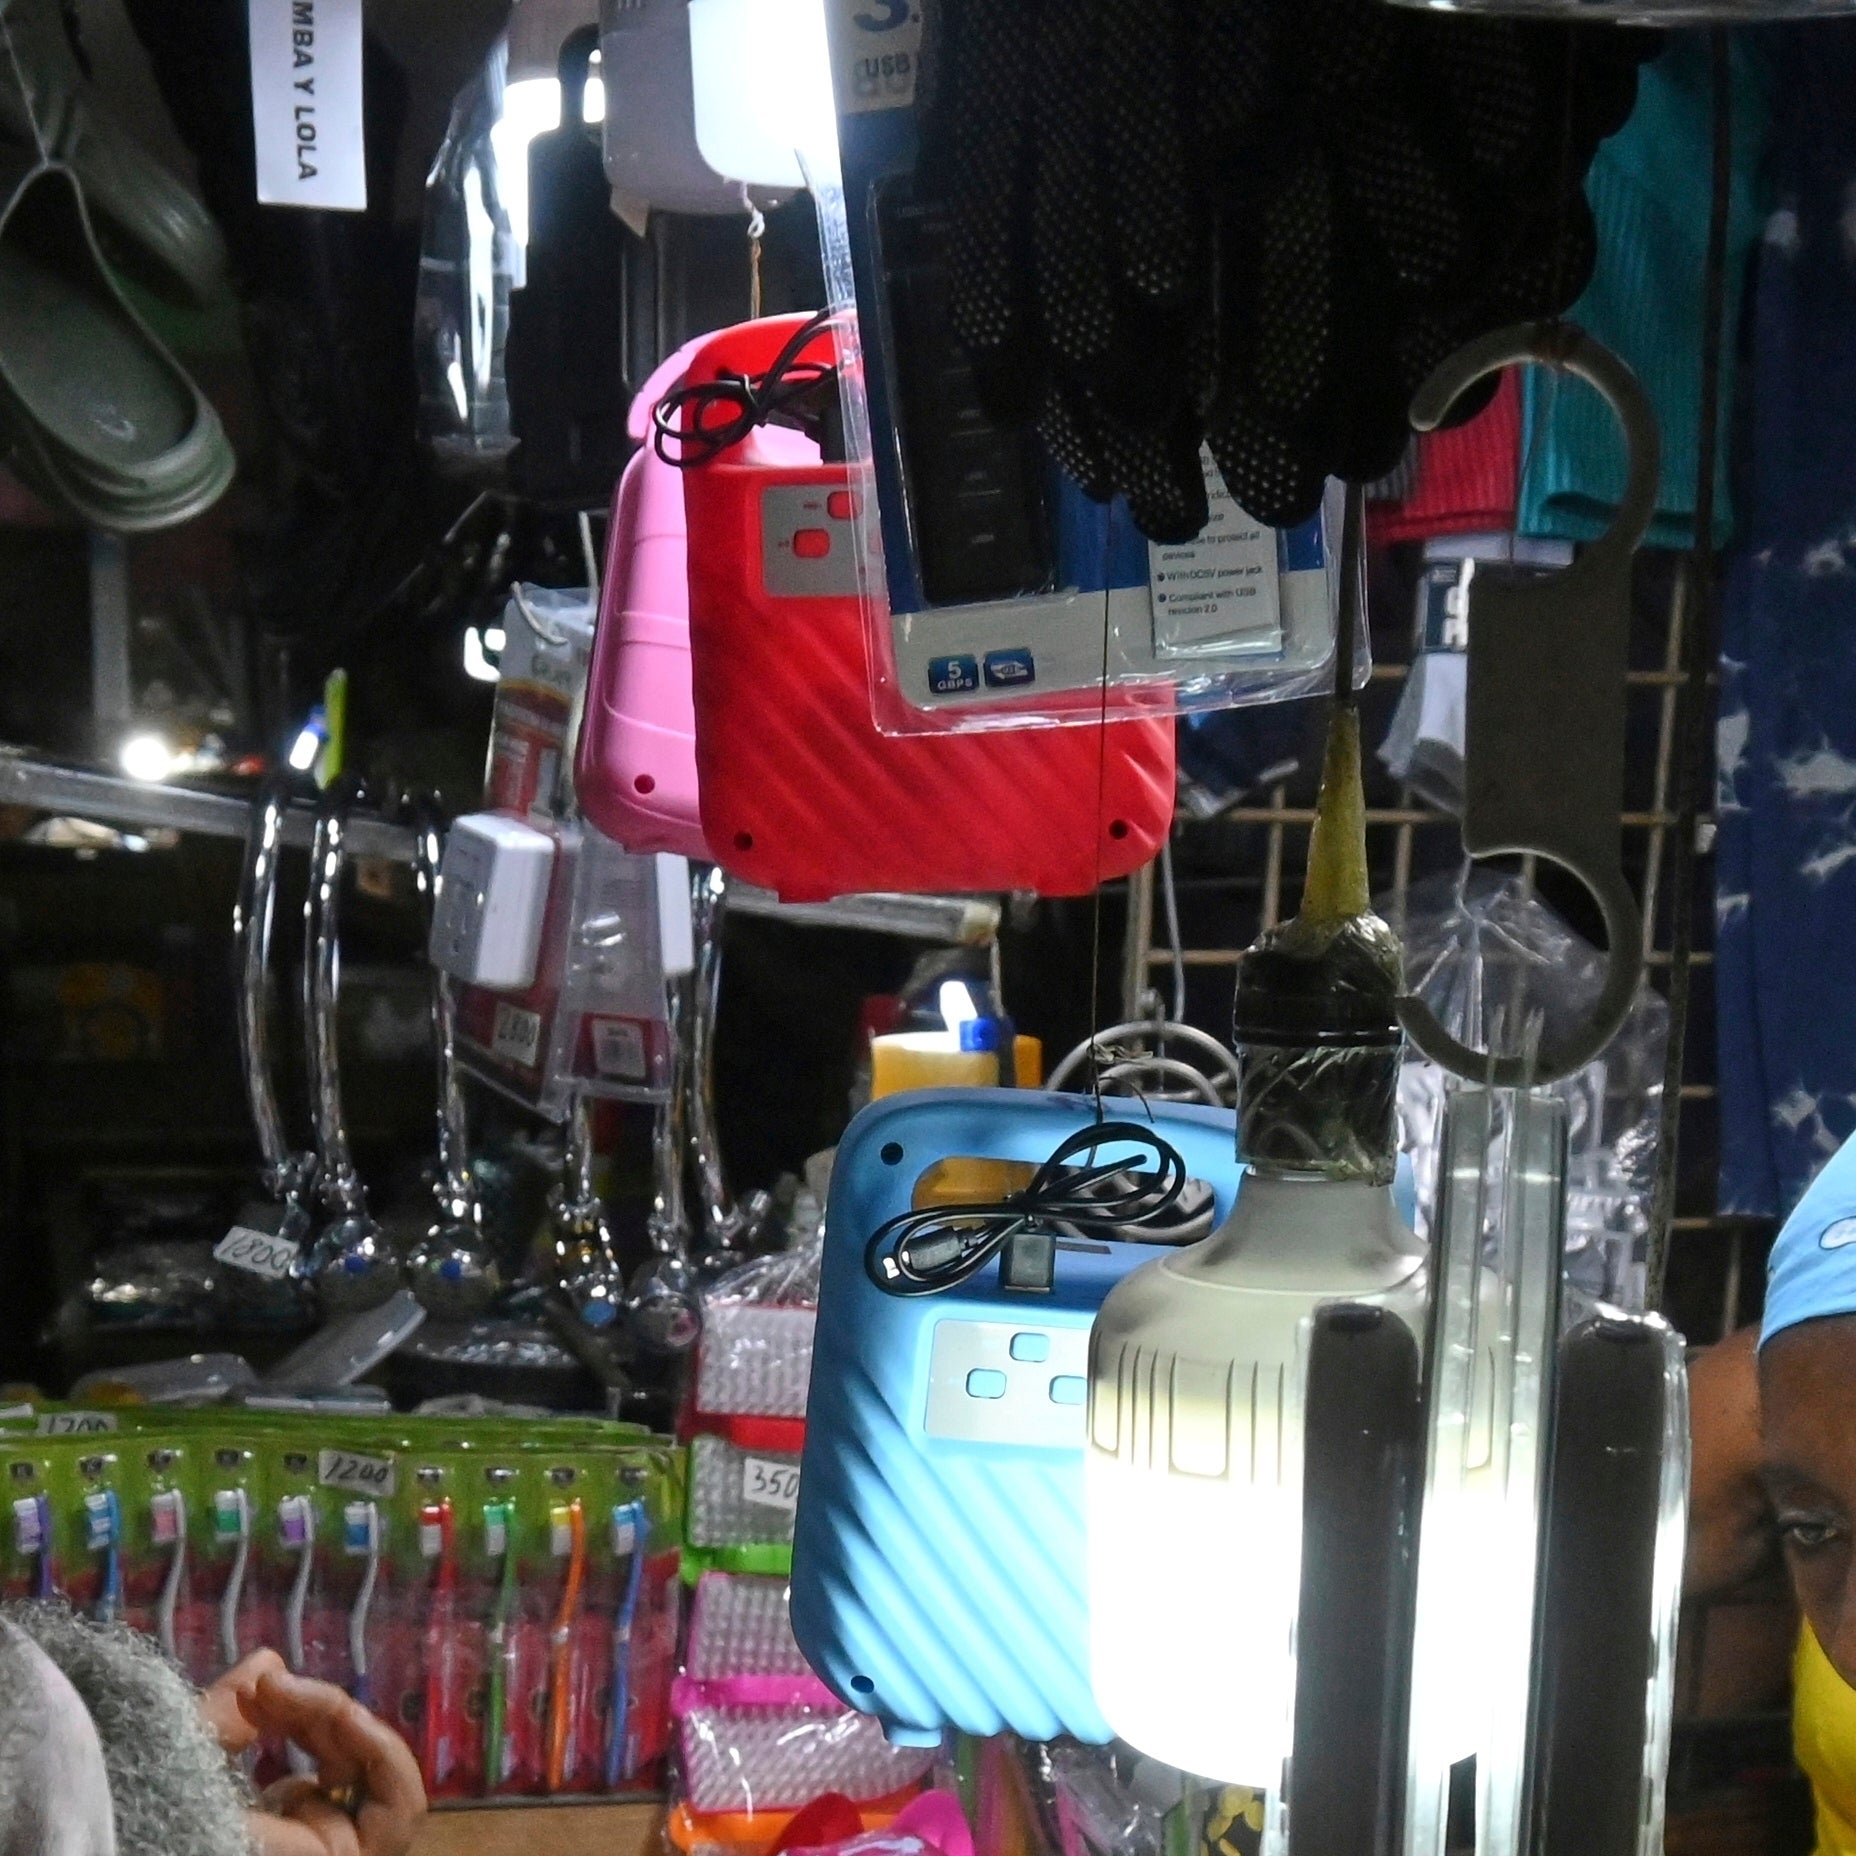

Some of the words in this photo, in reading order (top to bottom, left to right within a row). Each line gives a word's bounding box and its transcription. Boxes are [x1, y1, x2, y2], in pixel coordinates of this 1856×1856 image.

[294, 77, 315, 95] Y
[294, 105, 318, 181] LOLA
[947, 660, 962, 678] 5
[324, 1456, 389, 1484] 1200
[751, 1464, 801, 1499] 350
